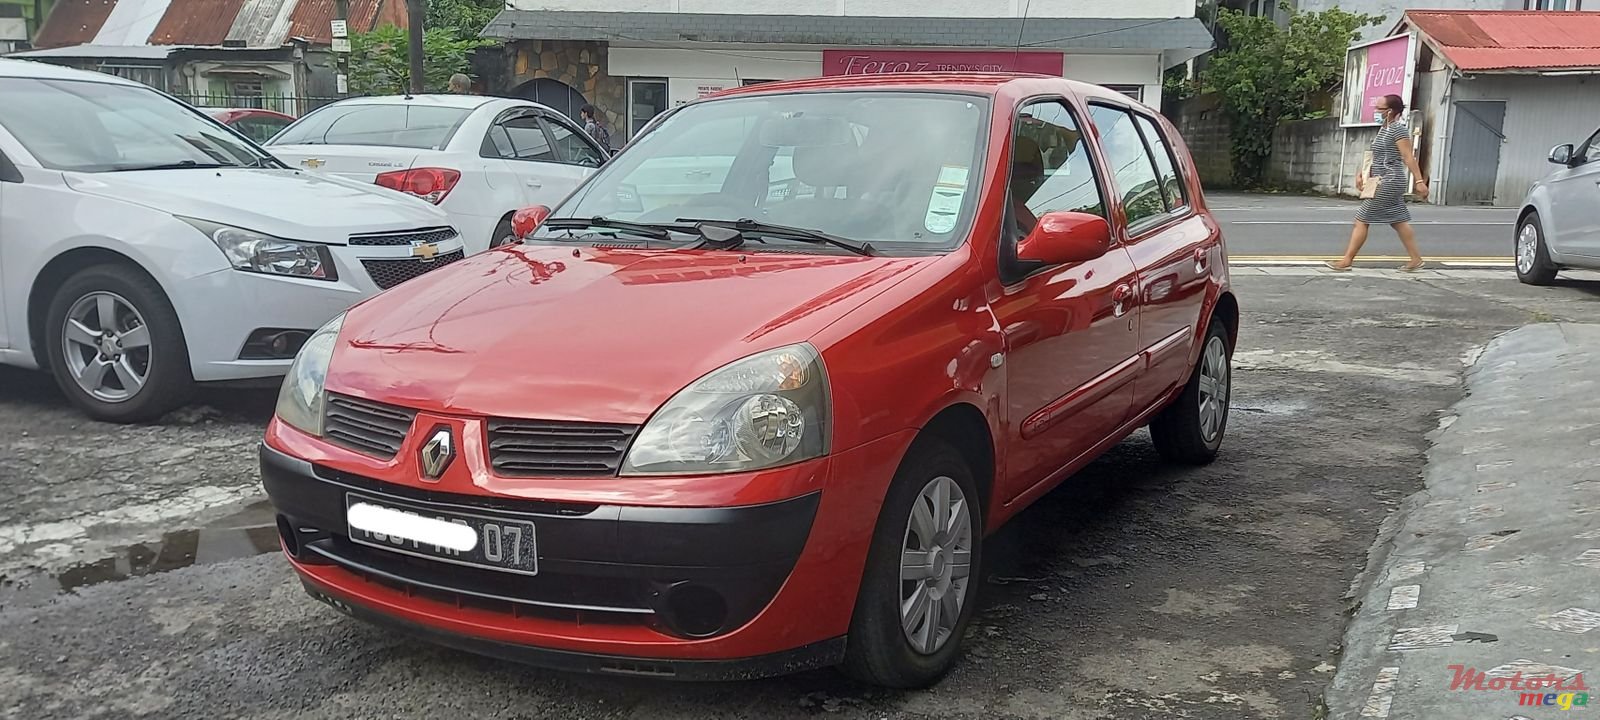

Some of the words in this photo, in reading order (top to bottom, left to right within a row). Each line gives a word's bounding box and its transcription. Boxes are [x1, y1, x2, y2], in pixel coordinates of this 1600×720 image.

[839, 55, 930, 75] Feroz
[936, 63, 980, 72] TRENDY'S
[982, 63, 1003, 72] CITY
[1366, 63, 1404, 91] Feroz
[483, 523, 522, 565] 07
